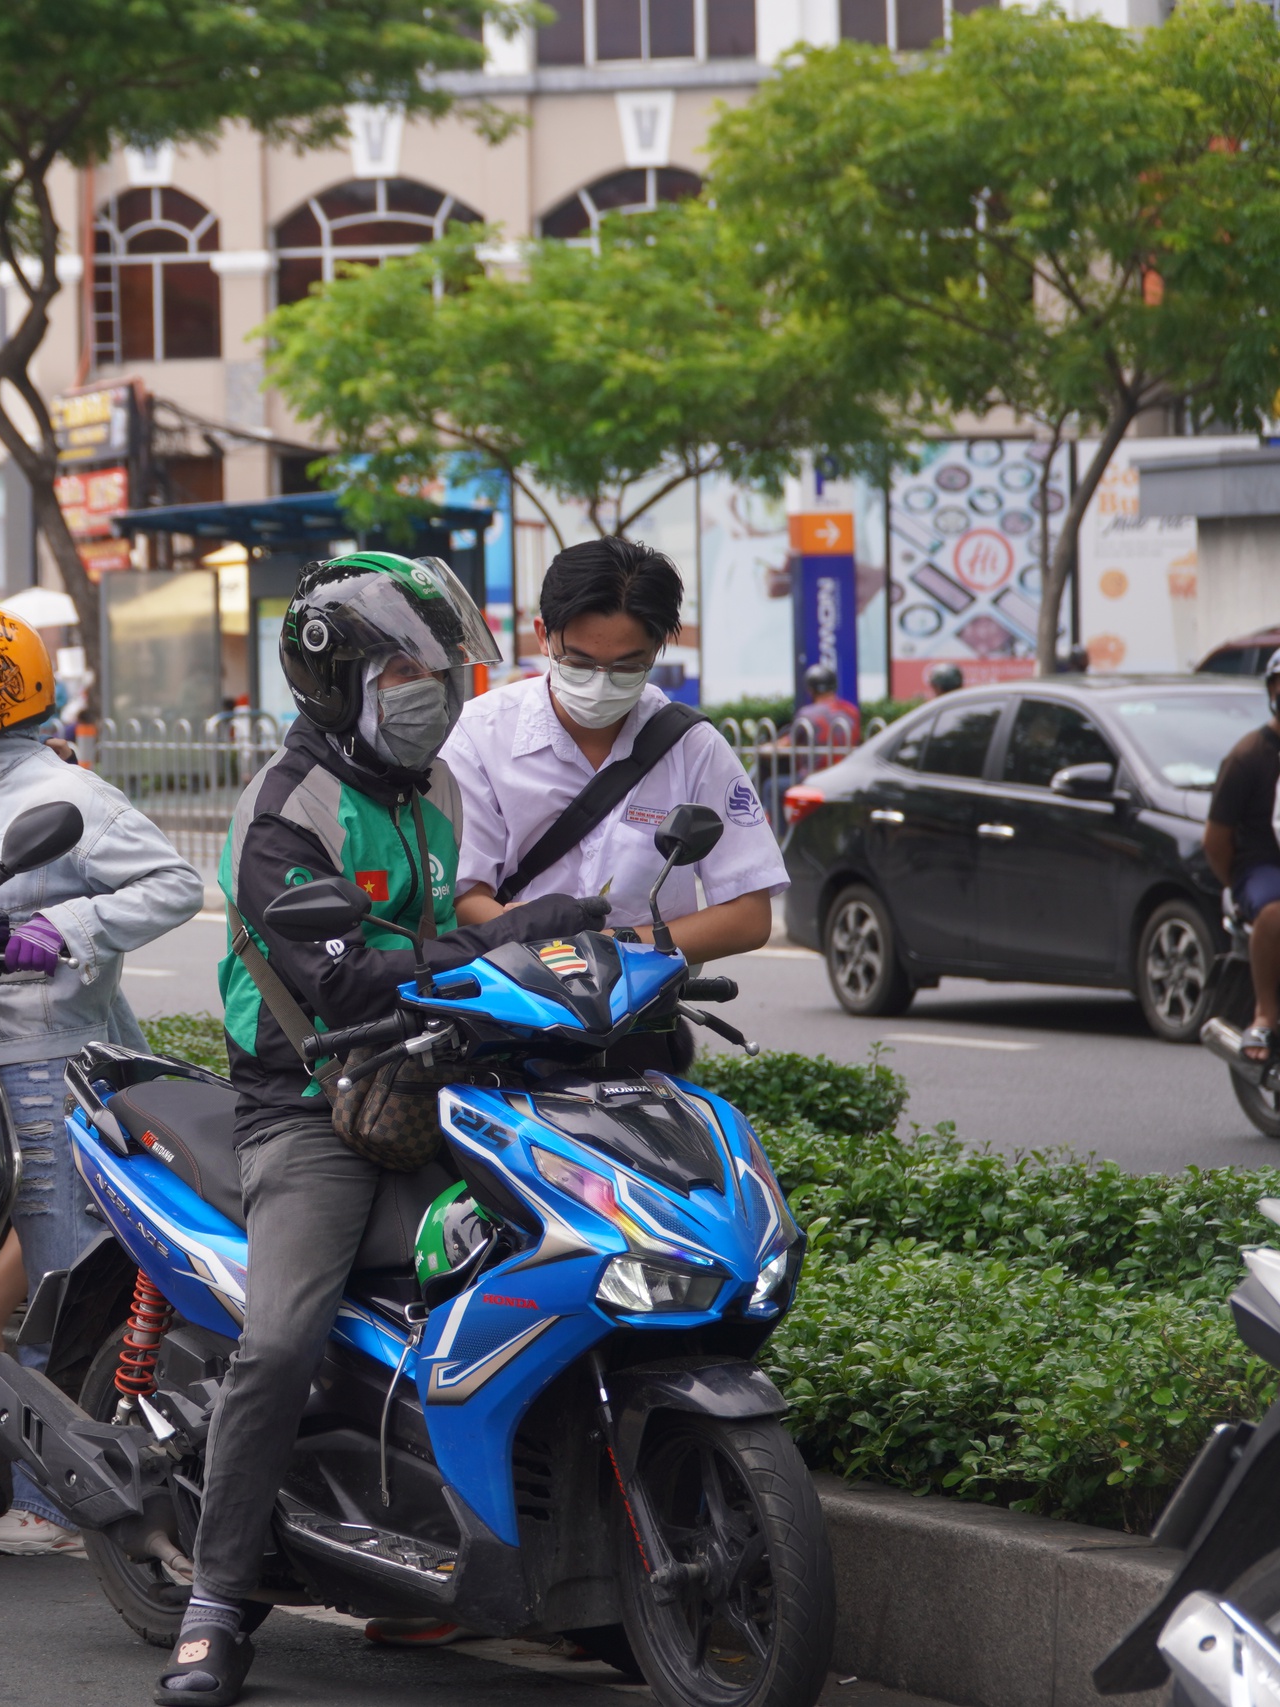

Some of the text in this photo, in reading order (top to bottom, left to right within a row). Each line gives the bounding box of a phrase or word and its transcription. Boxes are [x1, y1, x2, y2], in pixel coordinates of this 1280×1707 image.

[431, 882, 450, 900] ojek
[602, 1085, 652, 1097] HONDA
[483, 1293, 539, 1310] HONDA
